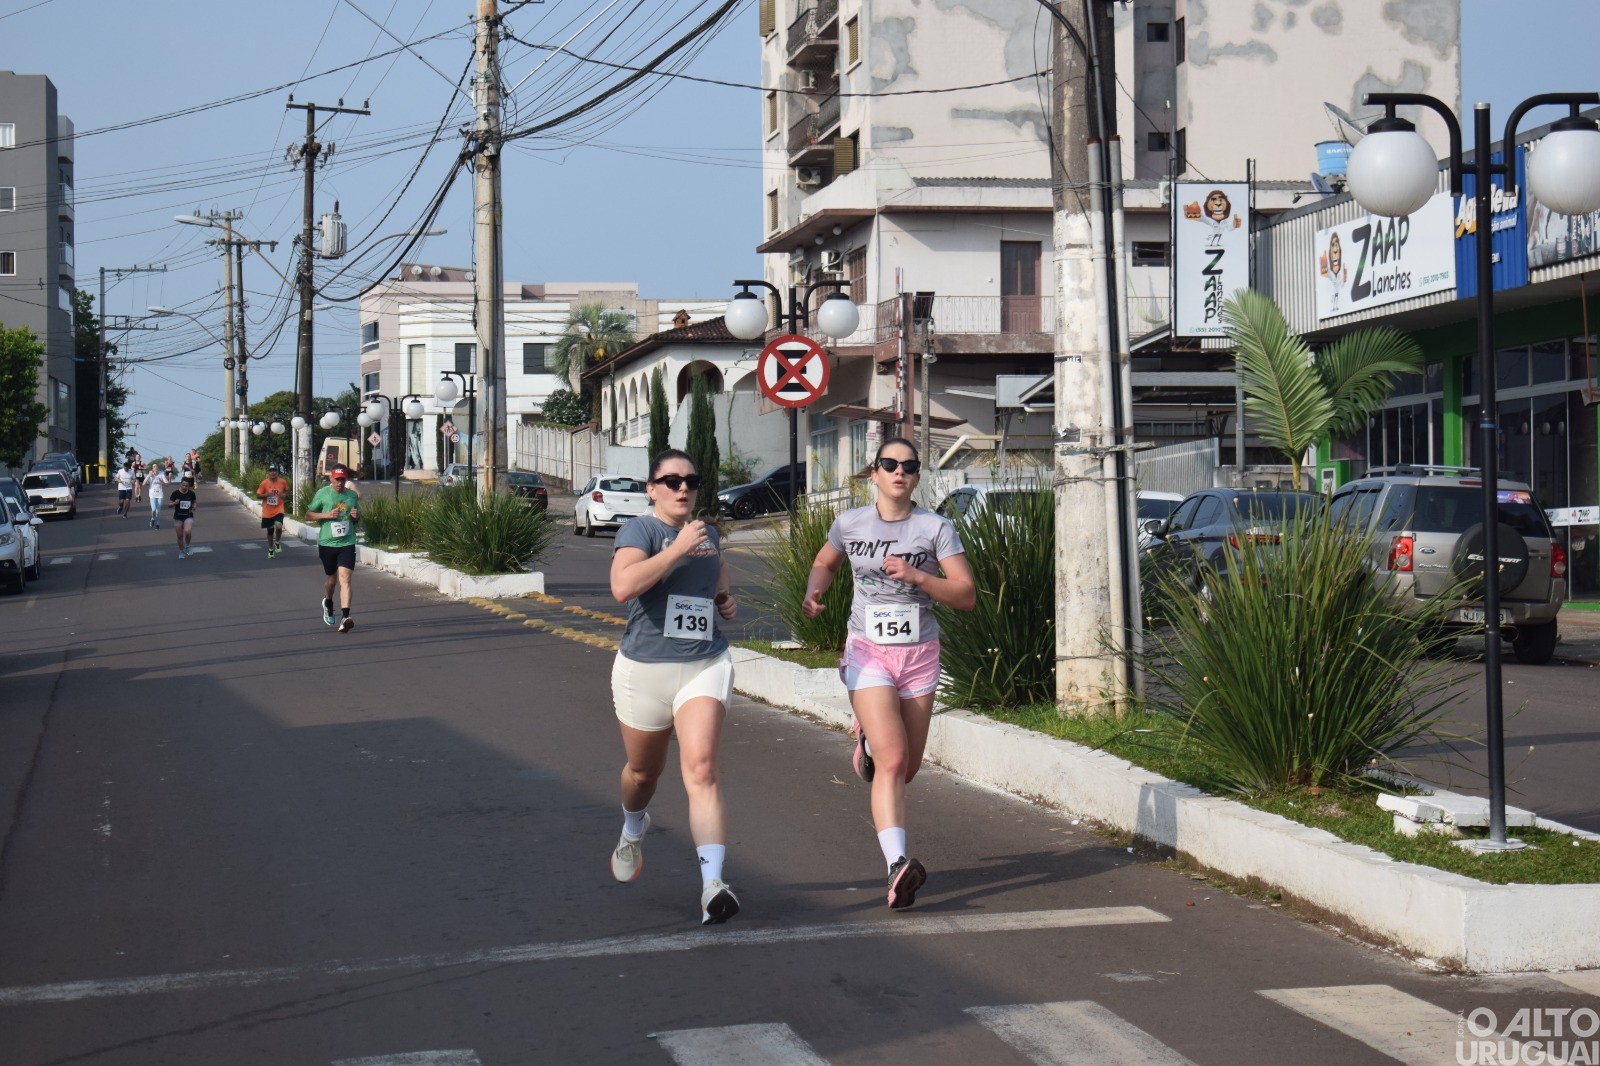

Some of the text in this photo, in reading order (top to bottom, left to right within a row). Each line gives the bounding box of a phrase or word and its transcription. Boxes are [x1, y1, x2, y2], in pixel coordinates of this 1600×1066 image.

[1351, 214, 1410, 303] ZAAP
[1202, 249, 1226, 324] ZAAP
[1371, 265, 1412, 298] Lanches
[849, 539, 899, 558] DON'T
[673, 614, 708, 632] 139
[874, 621, 912, 637] 154
